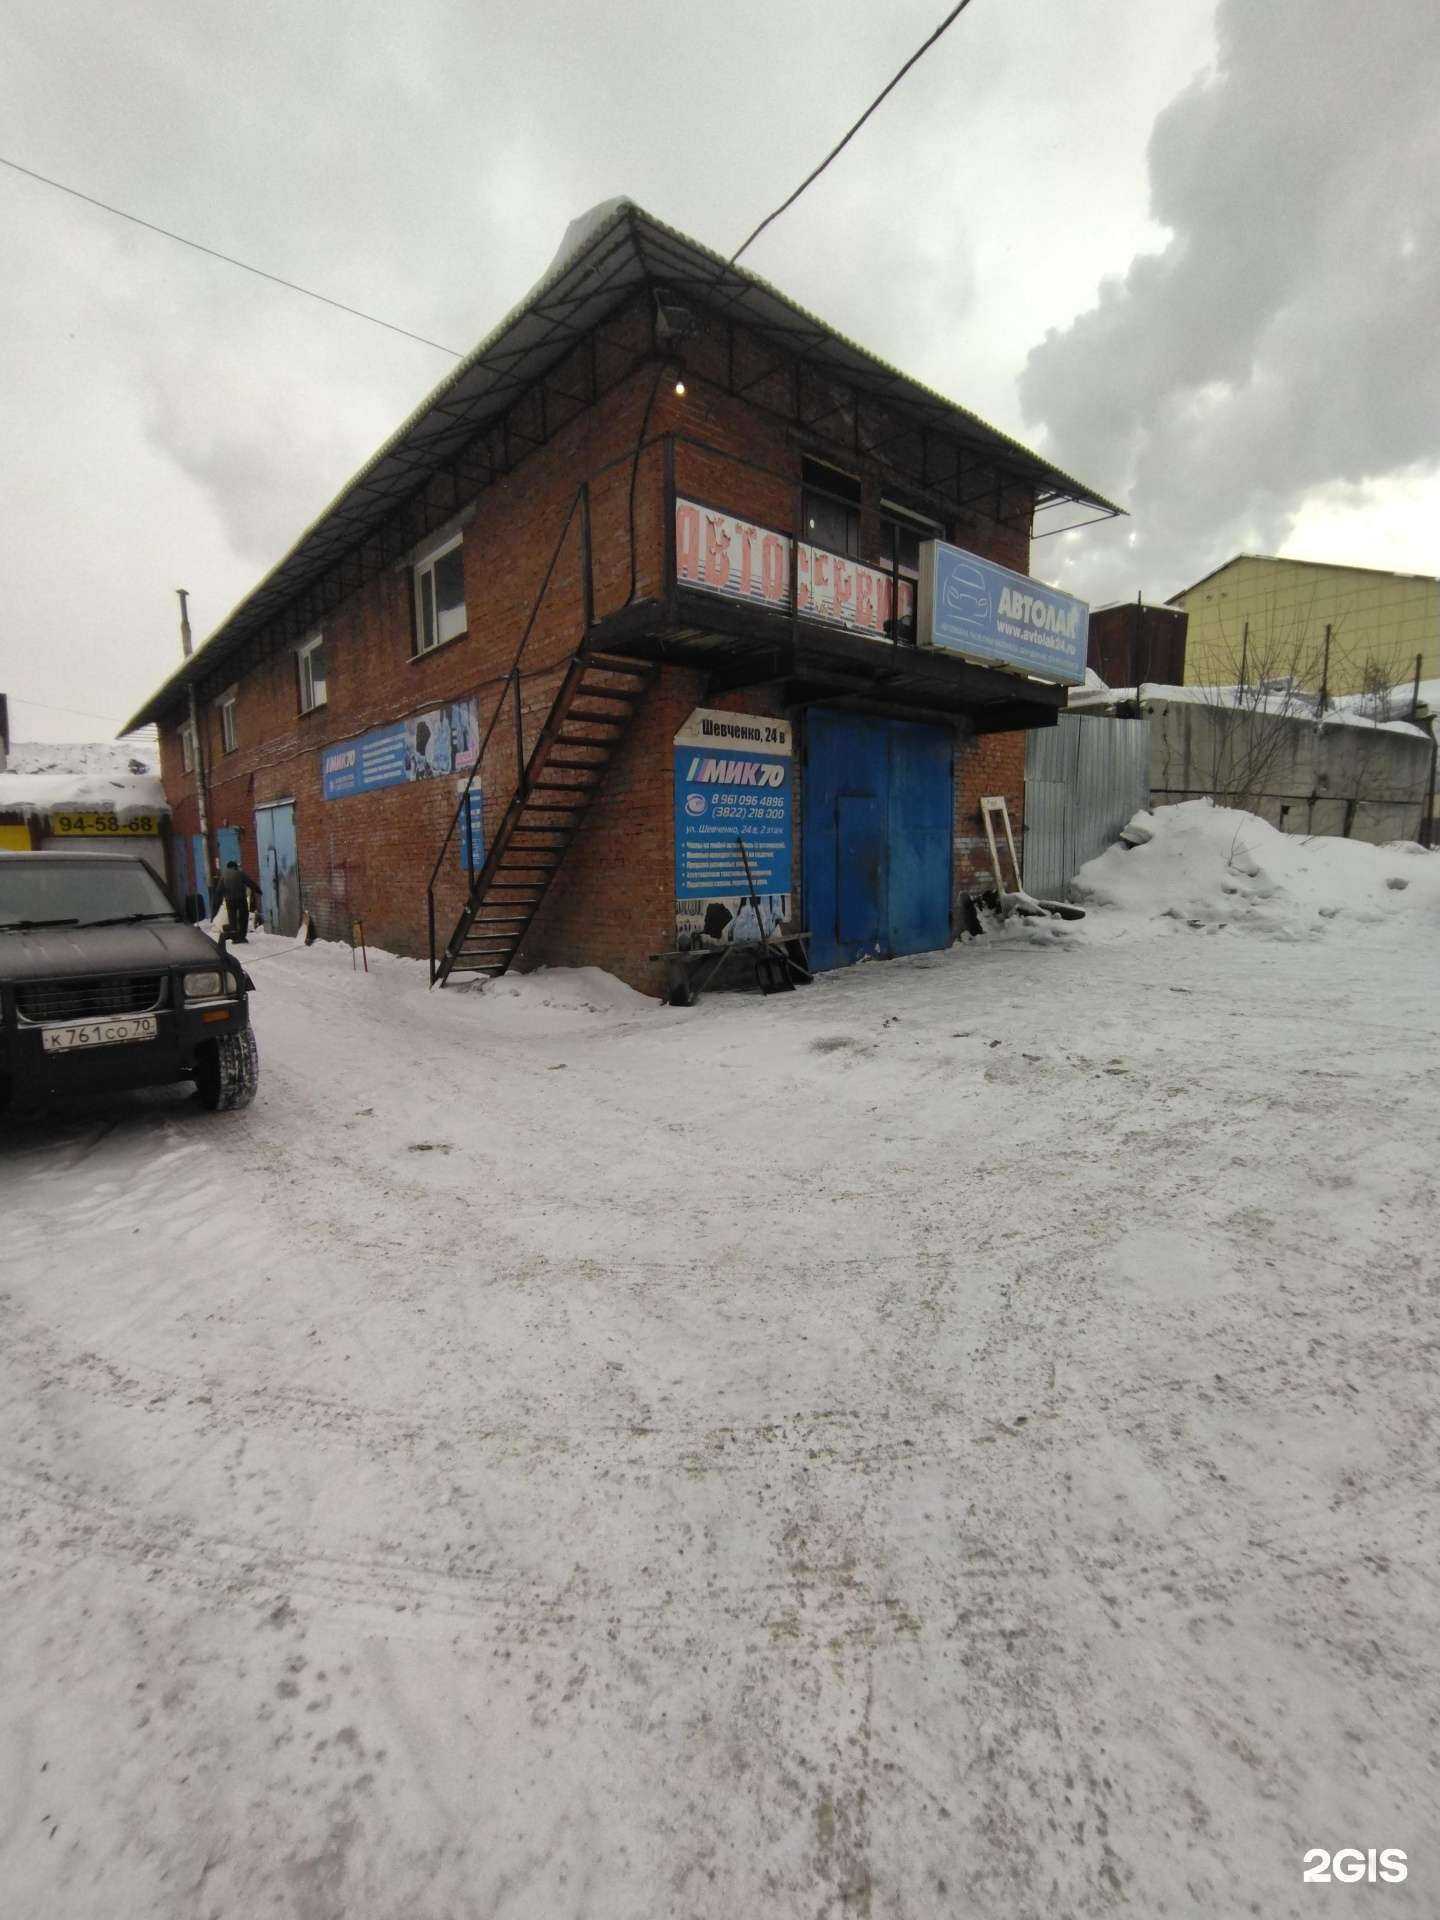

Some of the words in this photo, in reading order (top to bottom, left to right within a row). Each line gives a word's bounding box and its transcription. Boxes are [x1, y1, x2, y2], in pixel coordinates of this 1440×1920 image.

[998, 586, 1078, 640] АВТОЛАК
[702, 719, 763, 744] Шевченко,
[765, 727, 777, 743] 24
[711, 793, 719, 804] 8
[720, 794, 738, 805] 961
[739, 795, 758, 805] 096
[712, 806, 747, 819] (3822)
[748, 807, 764, 819] 218
[59, 815, 153, 833] 94-58-68
